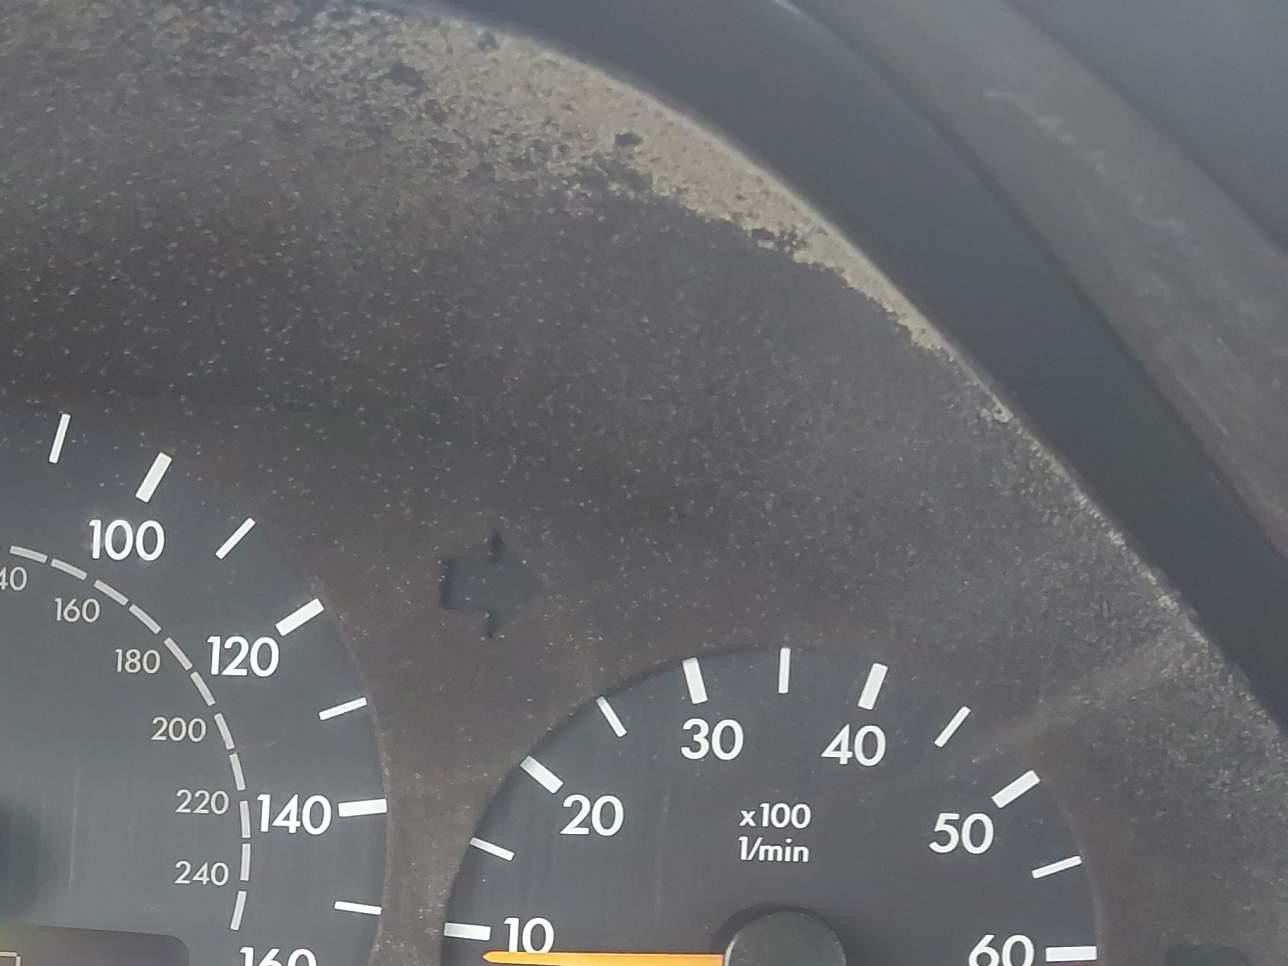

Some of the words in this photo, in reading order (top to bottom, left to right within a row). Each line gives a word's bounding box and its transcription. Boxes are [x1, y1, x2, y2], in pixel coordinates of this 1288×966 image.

[89, 519, 165, 561] 100
[54, 597, 101, 623] 160
[114, 648, 161, 674] 180
[207, 636, 280, 677] 120
[151, 716, 207, 742] 200
[680, 718, 744, 761] 30
[820, 724, 887, 767] 40
[175, 789, 230, 815] 220
[257, 793, 332, 836] 140
[560, 794, 624, 837] 20
[739, 802, 812, 831] x100
[738, 836, 810, 864] 1/min
[928, 812, 994, 855] 50
[175, 861, 230, 887] 240
[503, 916, 555, 955] 10
